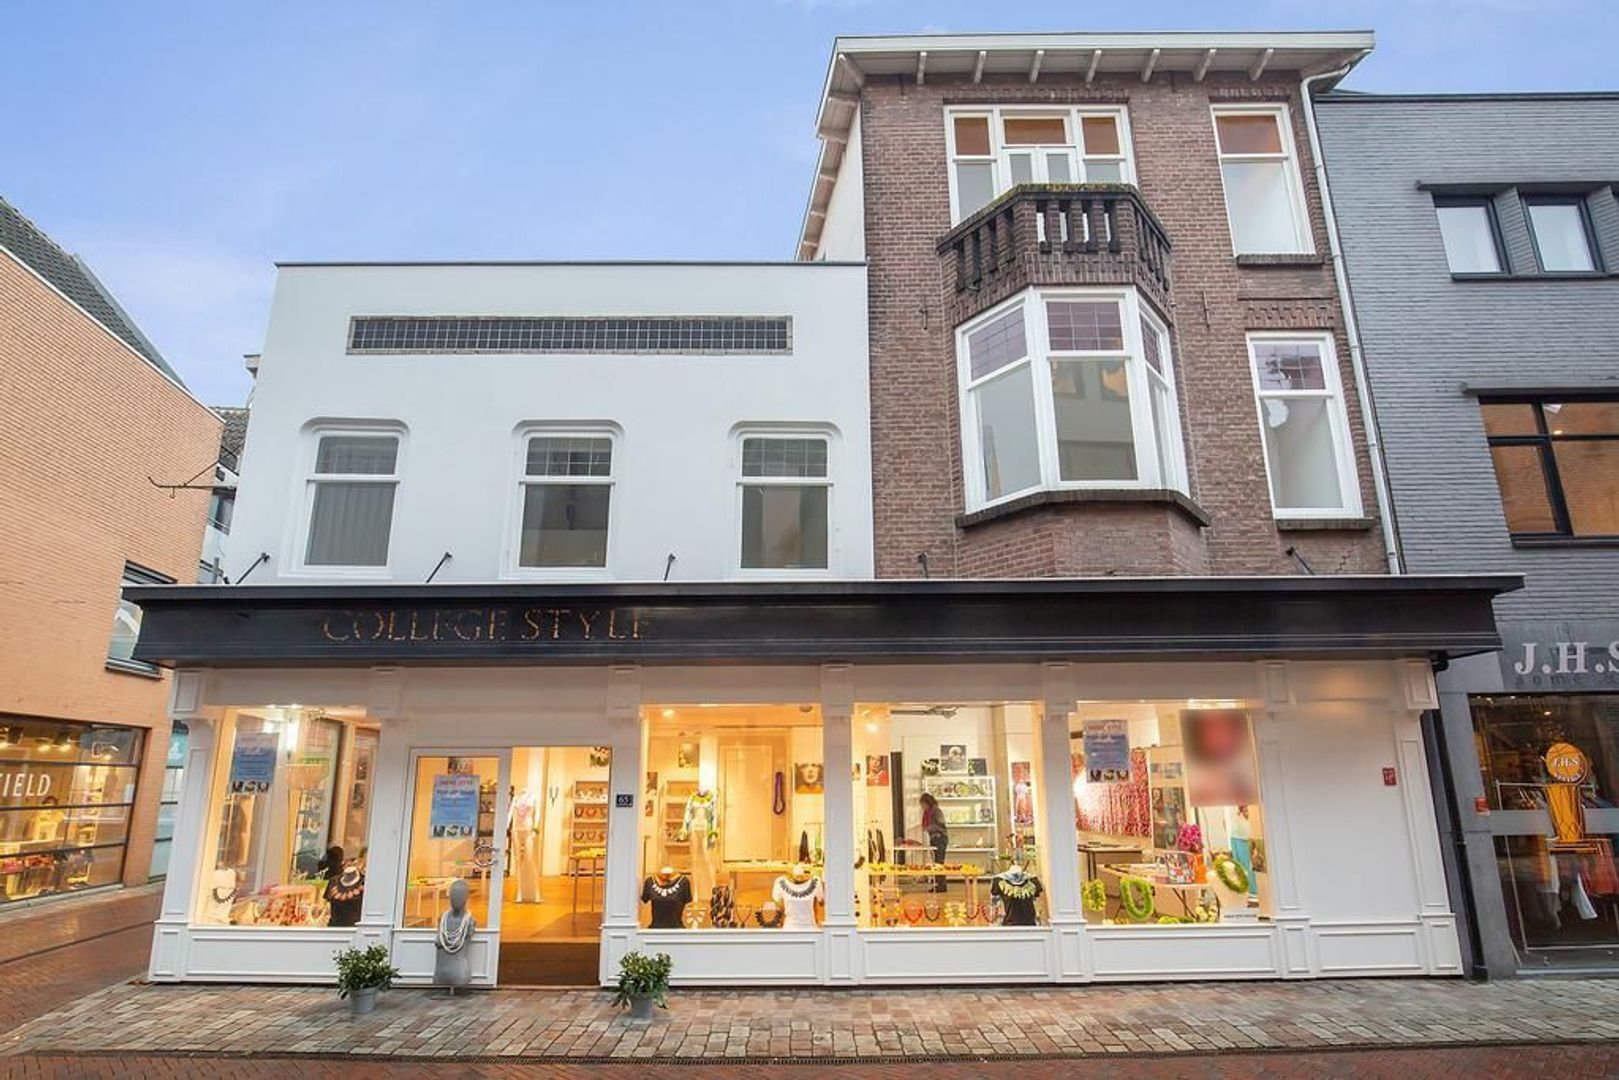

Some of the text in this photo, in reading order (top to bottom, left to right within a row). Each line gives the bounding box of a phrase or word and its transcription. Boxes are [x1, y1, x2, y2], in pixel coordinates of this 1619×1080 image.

[322, 608, 649, 641] COLLEGE STYLE
[0, 773, 51, 797] IELD
